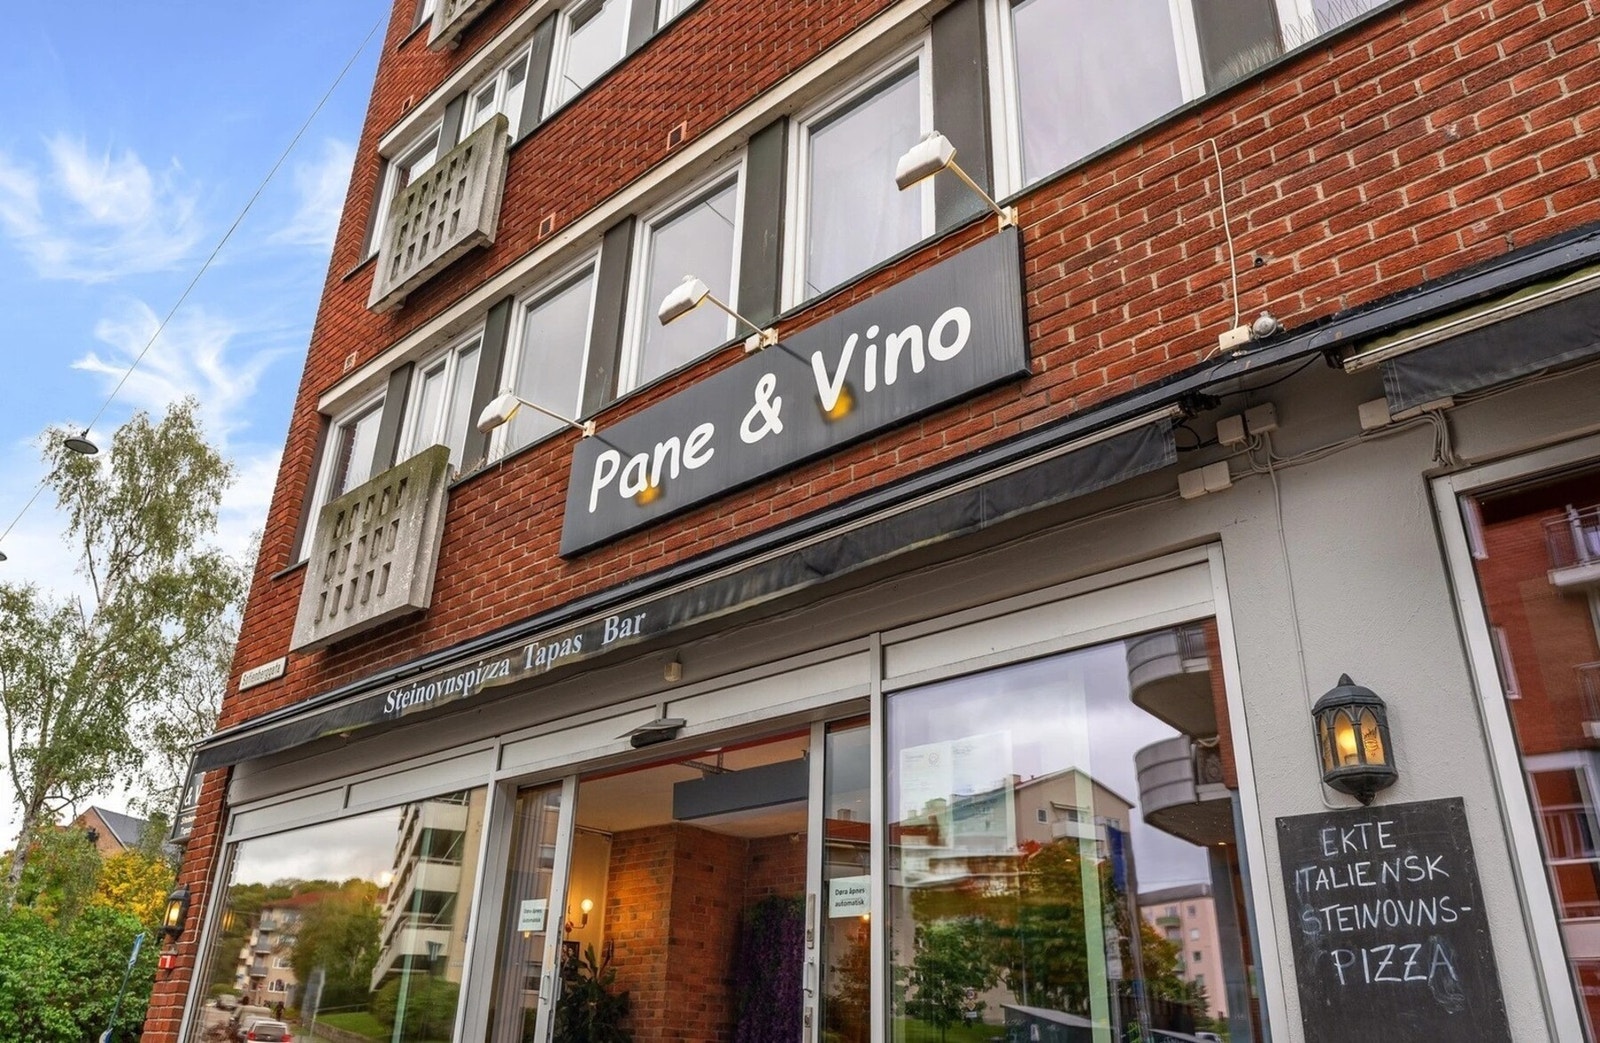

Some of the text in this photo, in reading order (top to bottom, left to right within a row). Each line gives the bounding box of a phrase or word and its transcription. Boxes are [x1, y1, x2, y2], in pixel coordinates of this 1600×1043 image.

[588, 306, 972, 513] Pane & Vino
[383, 612, 647, 713] Steinovnspizza Tapas Bar
[1321, 820, 1397, 857] EKTE
[1295, 855, 1450, 894] ITALIENSK
[1302, 895, 1472, 935] STEINOVNS-
[1330, 942, 1459, 986] PIZZA
